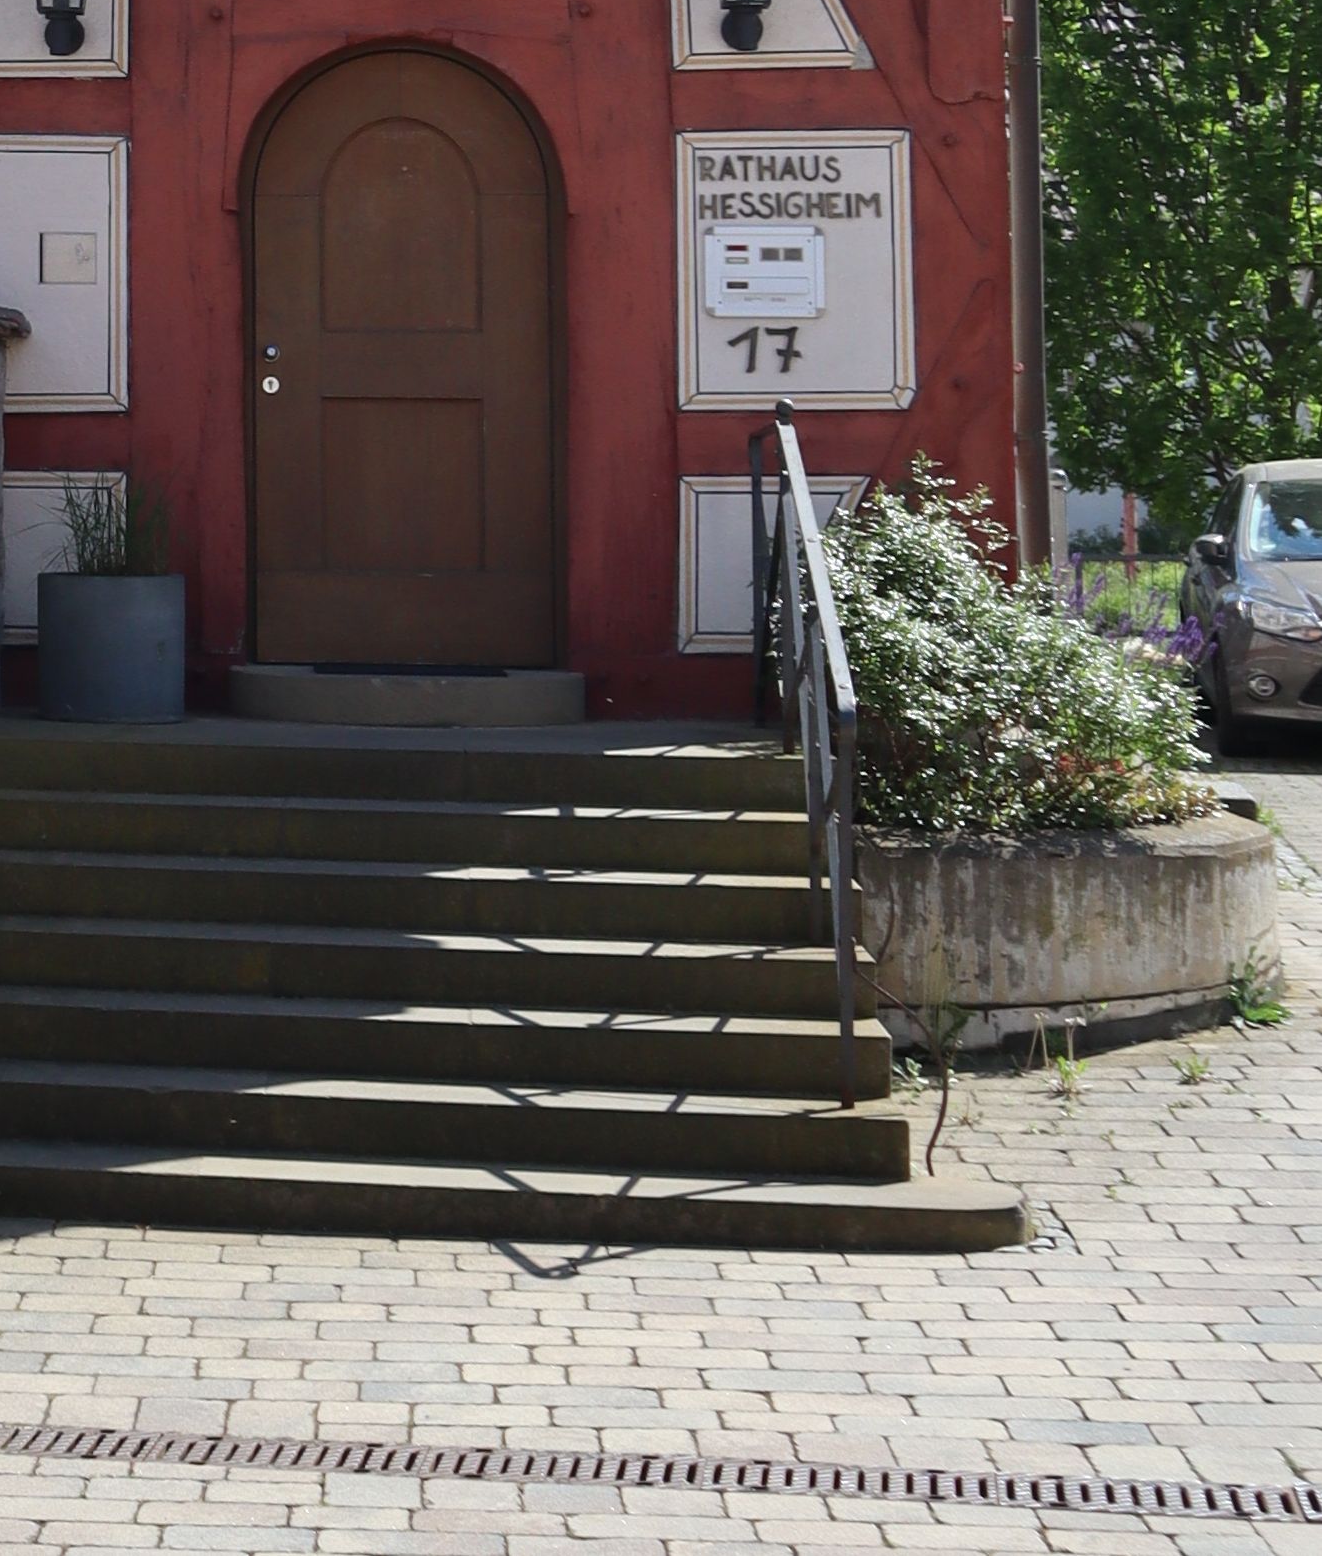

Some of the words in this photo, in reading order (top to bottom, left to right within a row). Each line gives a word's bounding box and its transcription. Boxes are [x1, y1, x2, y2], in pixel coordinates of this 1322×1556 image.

[697, 155, 841, 183] RATHAUS
[698, 191, 883, 220] HESSIGHEIM
[727, 326, 802, 373] 17
